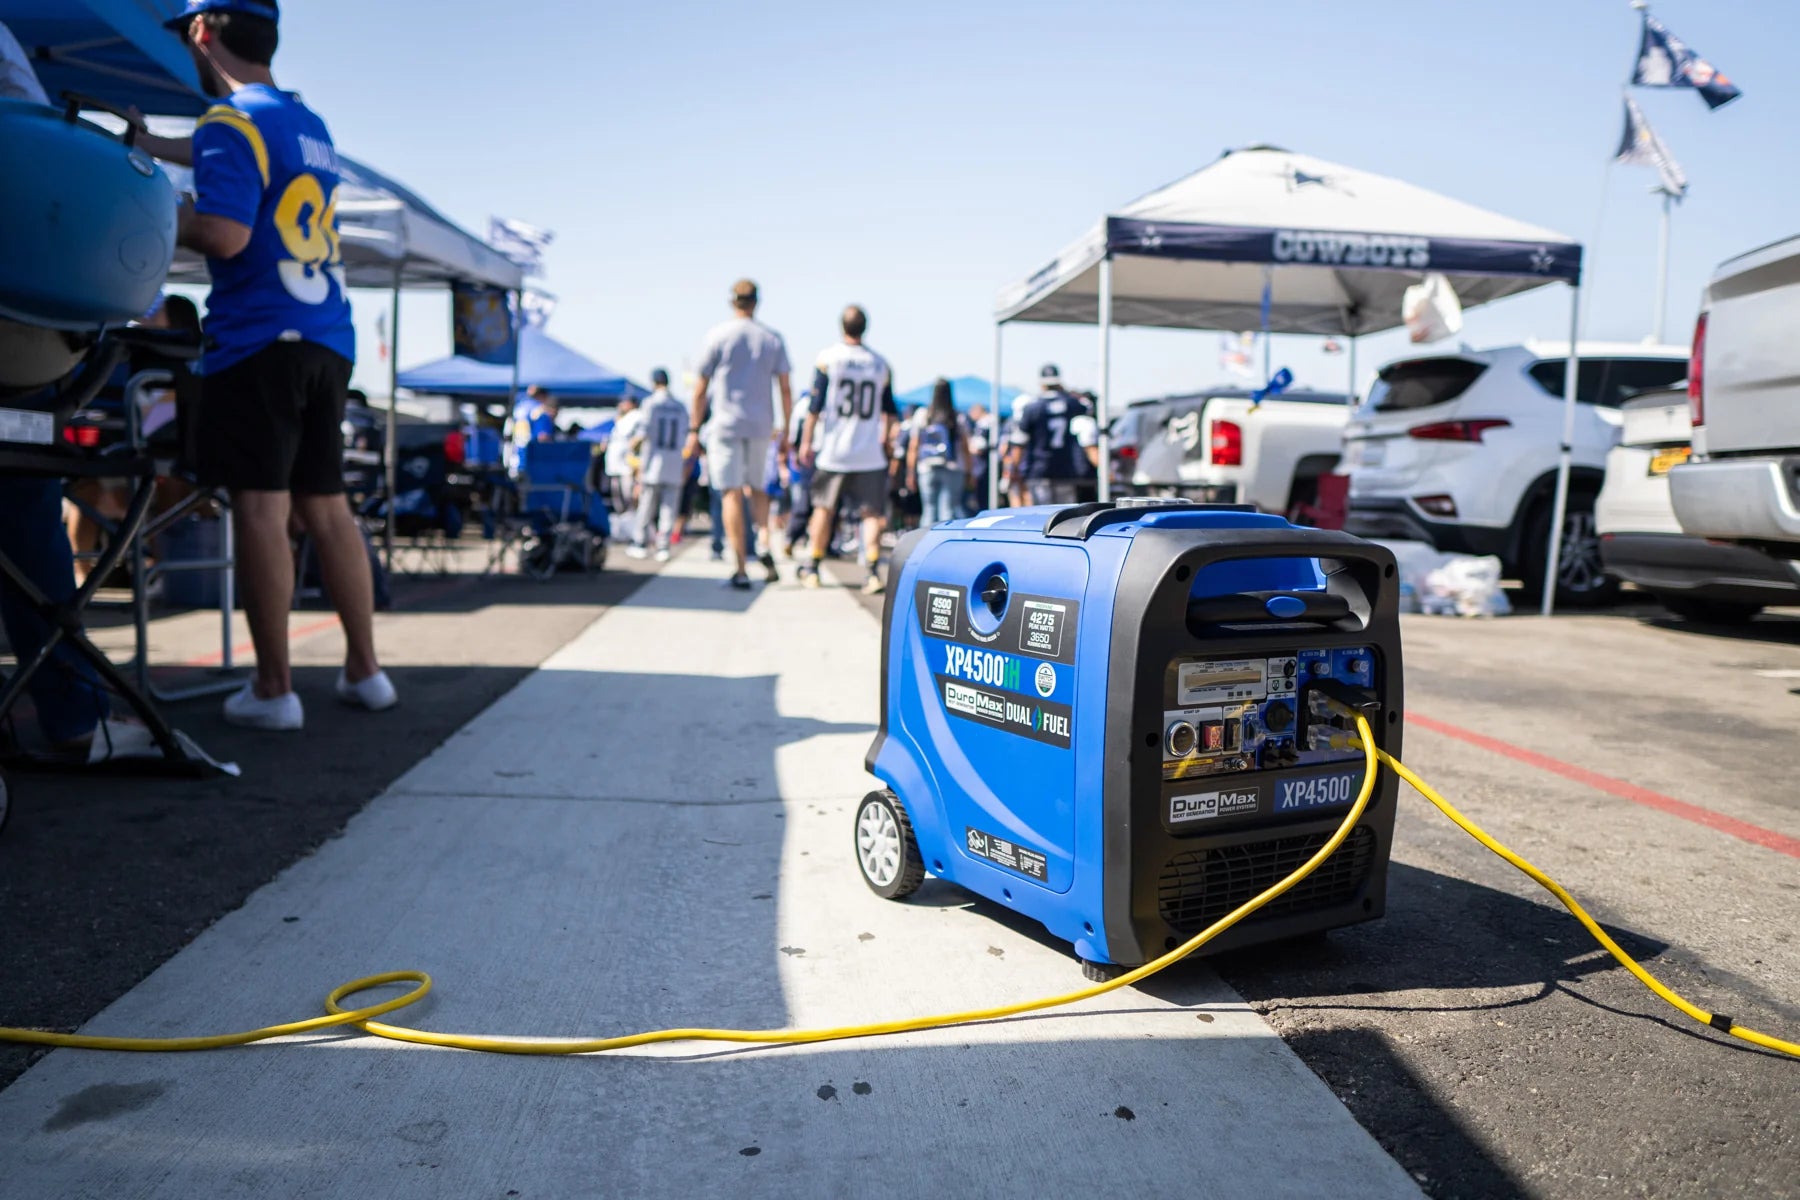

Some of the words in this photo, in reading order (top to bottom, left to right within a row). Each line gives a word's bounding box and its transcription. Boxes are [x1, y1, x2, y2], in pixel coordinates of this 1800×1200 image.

[1273, 230, 1430, 267] COWBOYS
[838, 378, 876, 420] 30
[657, 417, 679, 450] 11
[1047, 416, 1067, 449] 7
[932, 597, 952, 610] 4500
[1030, 612, 1055, 625] 4275
[1028, 622, 1039, 630] PEAK
[1039, 625, 1055, 633] WATTS
[1030, 632, 1050, 644] 3650
[1006, 702, 1032, 726] DUAL
[1043, 712, 1070, 737] FUEL
[1186, 809, 1215, 817] GENERATION
[1236, 803, 1256, 811] SYSTEMS
